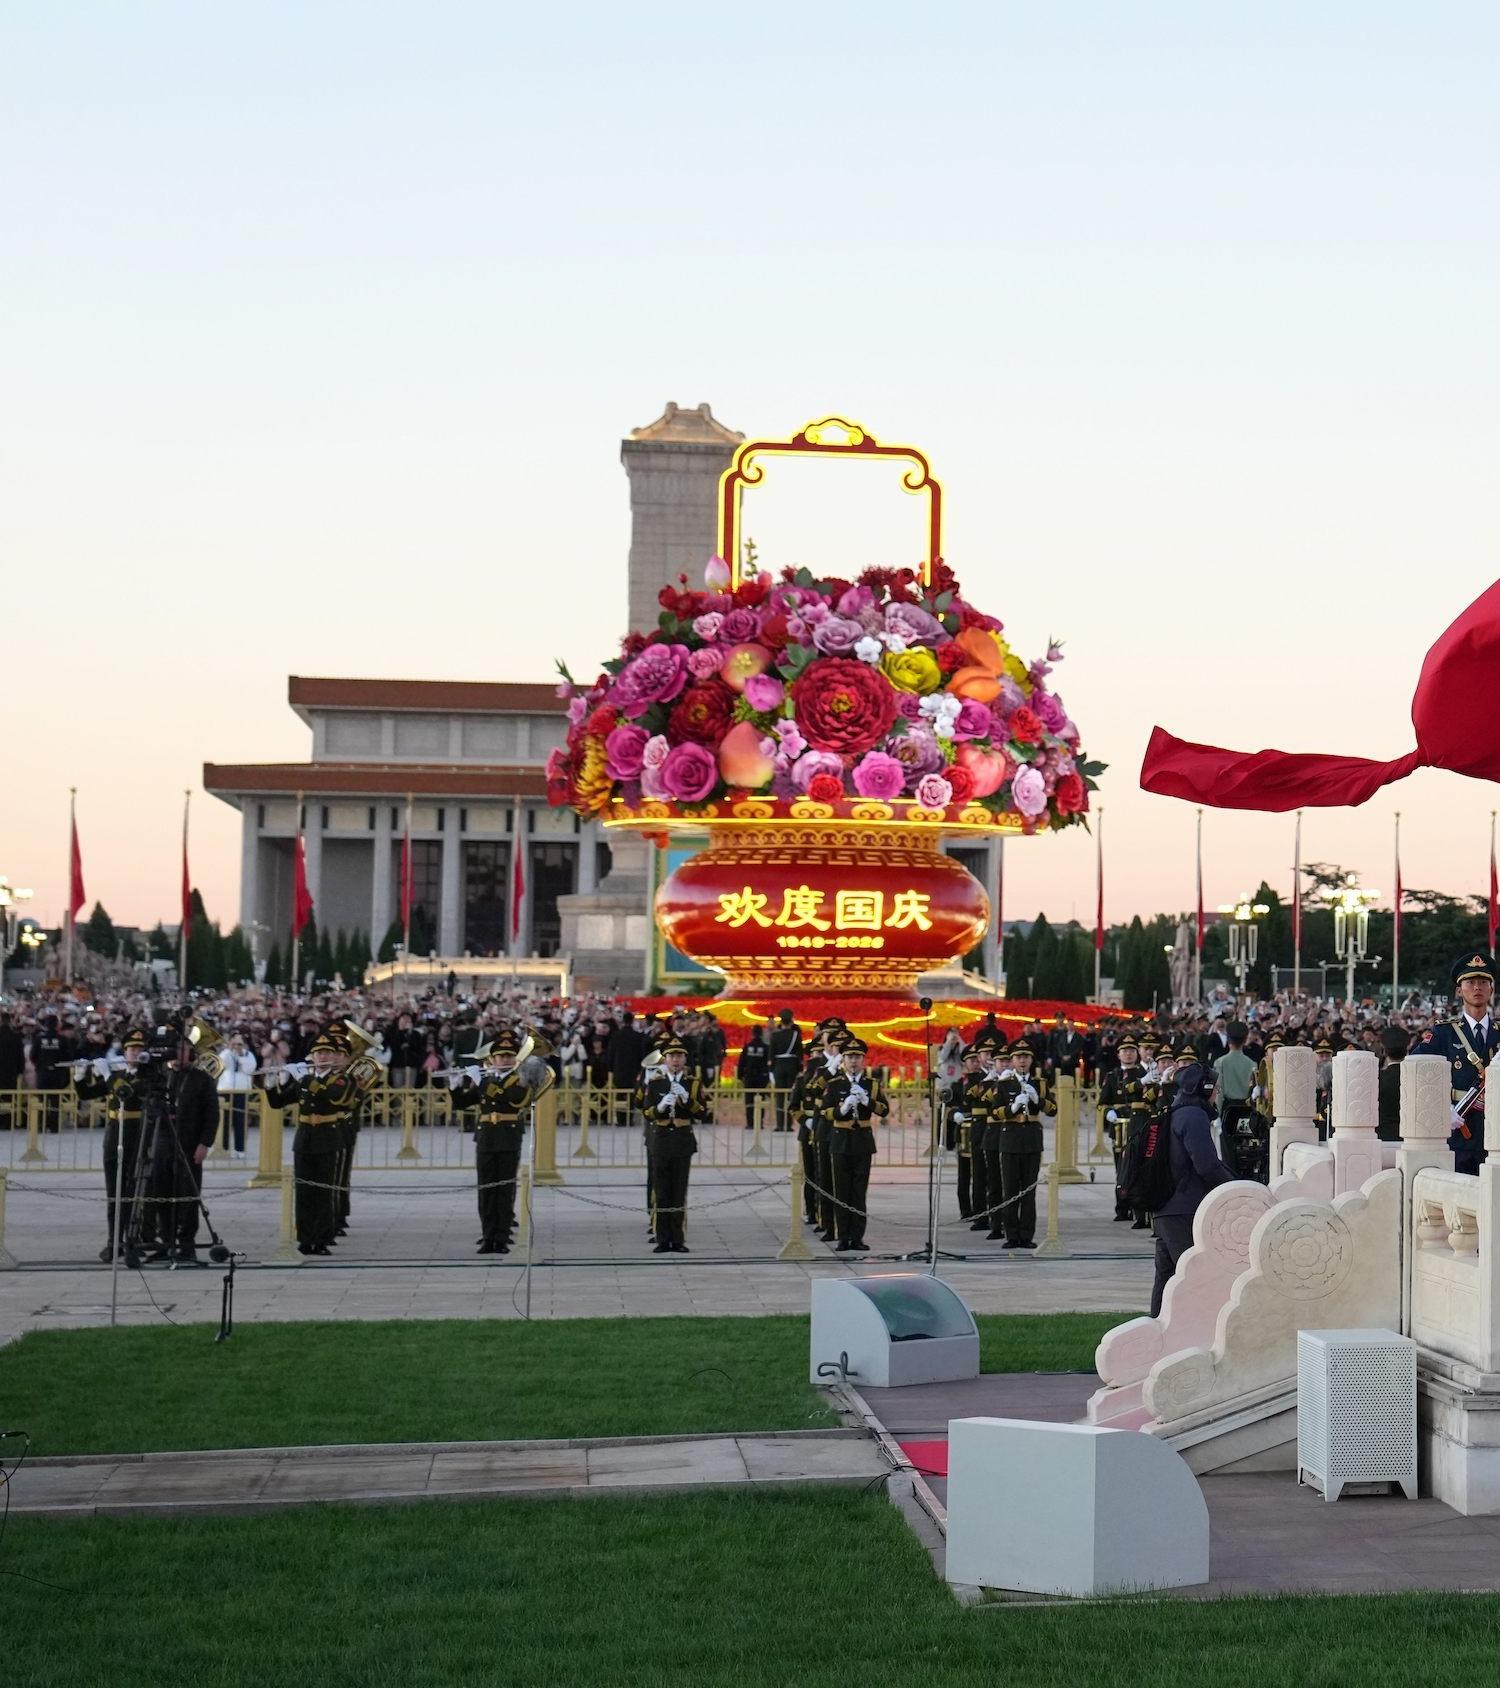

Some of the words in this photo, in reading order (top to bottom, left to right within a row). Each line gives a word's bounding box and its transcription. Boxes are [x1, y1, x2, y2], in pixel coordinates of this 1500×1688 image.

[714, 884, 933, 931] 欢度国庆
[1145, 1124, 1159, 1158] CHINA
